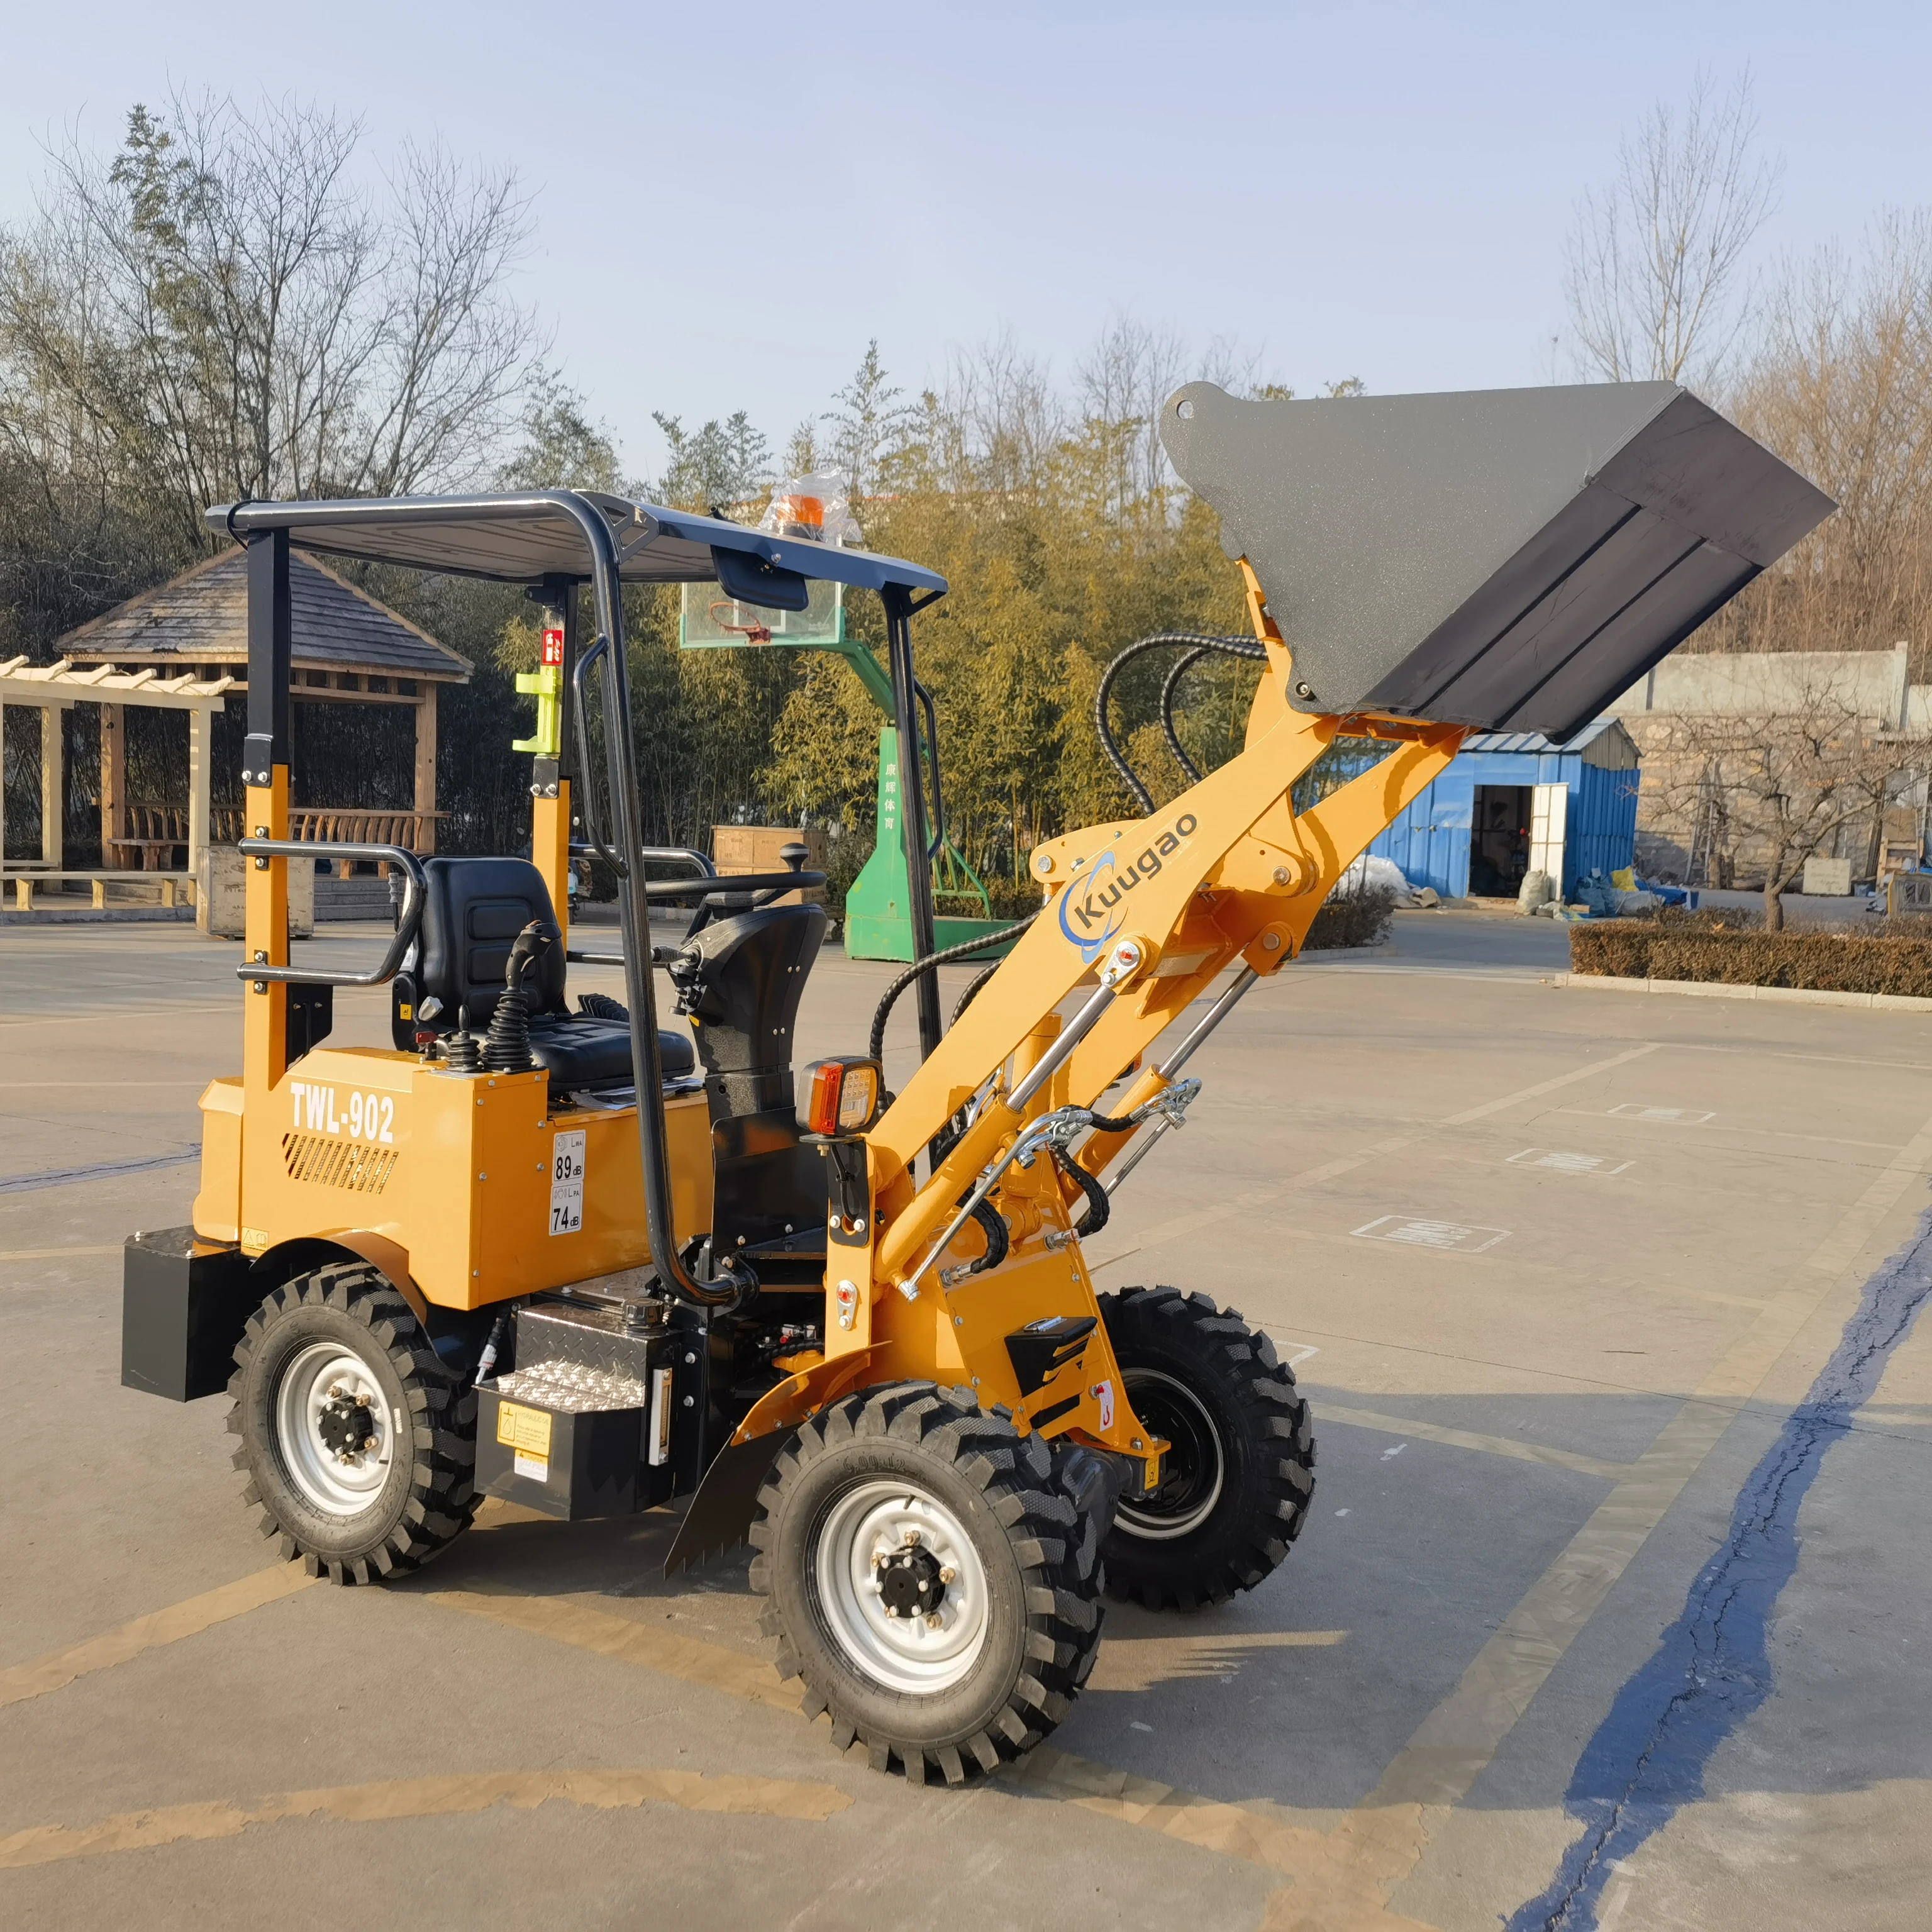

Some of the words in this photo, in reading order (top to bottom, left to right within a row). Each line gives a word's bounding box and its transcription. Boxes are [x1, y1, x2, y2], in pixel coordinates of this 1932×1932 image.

[1074, 813, 1197, 929] Kuugao
[290, 1081, 394, 1143] TWL-902
[556, 1155, 572, 1180] 89
[573, 1165, 582, 1176] dB
[553, 1206, 569, 1231] 74
[570, 1216, 579, 1226] dB
